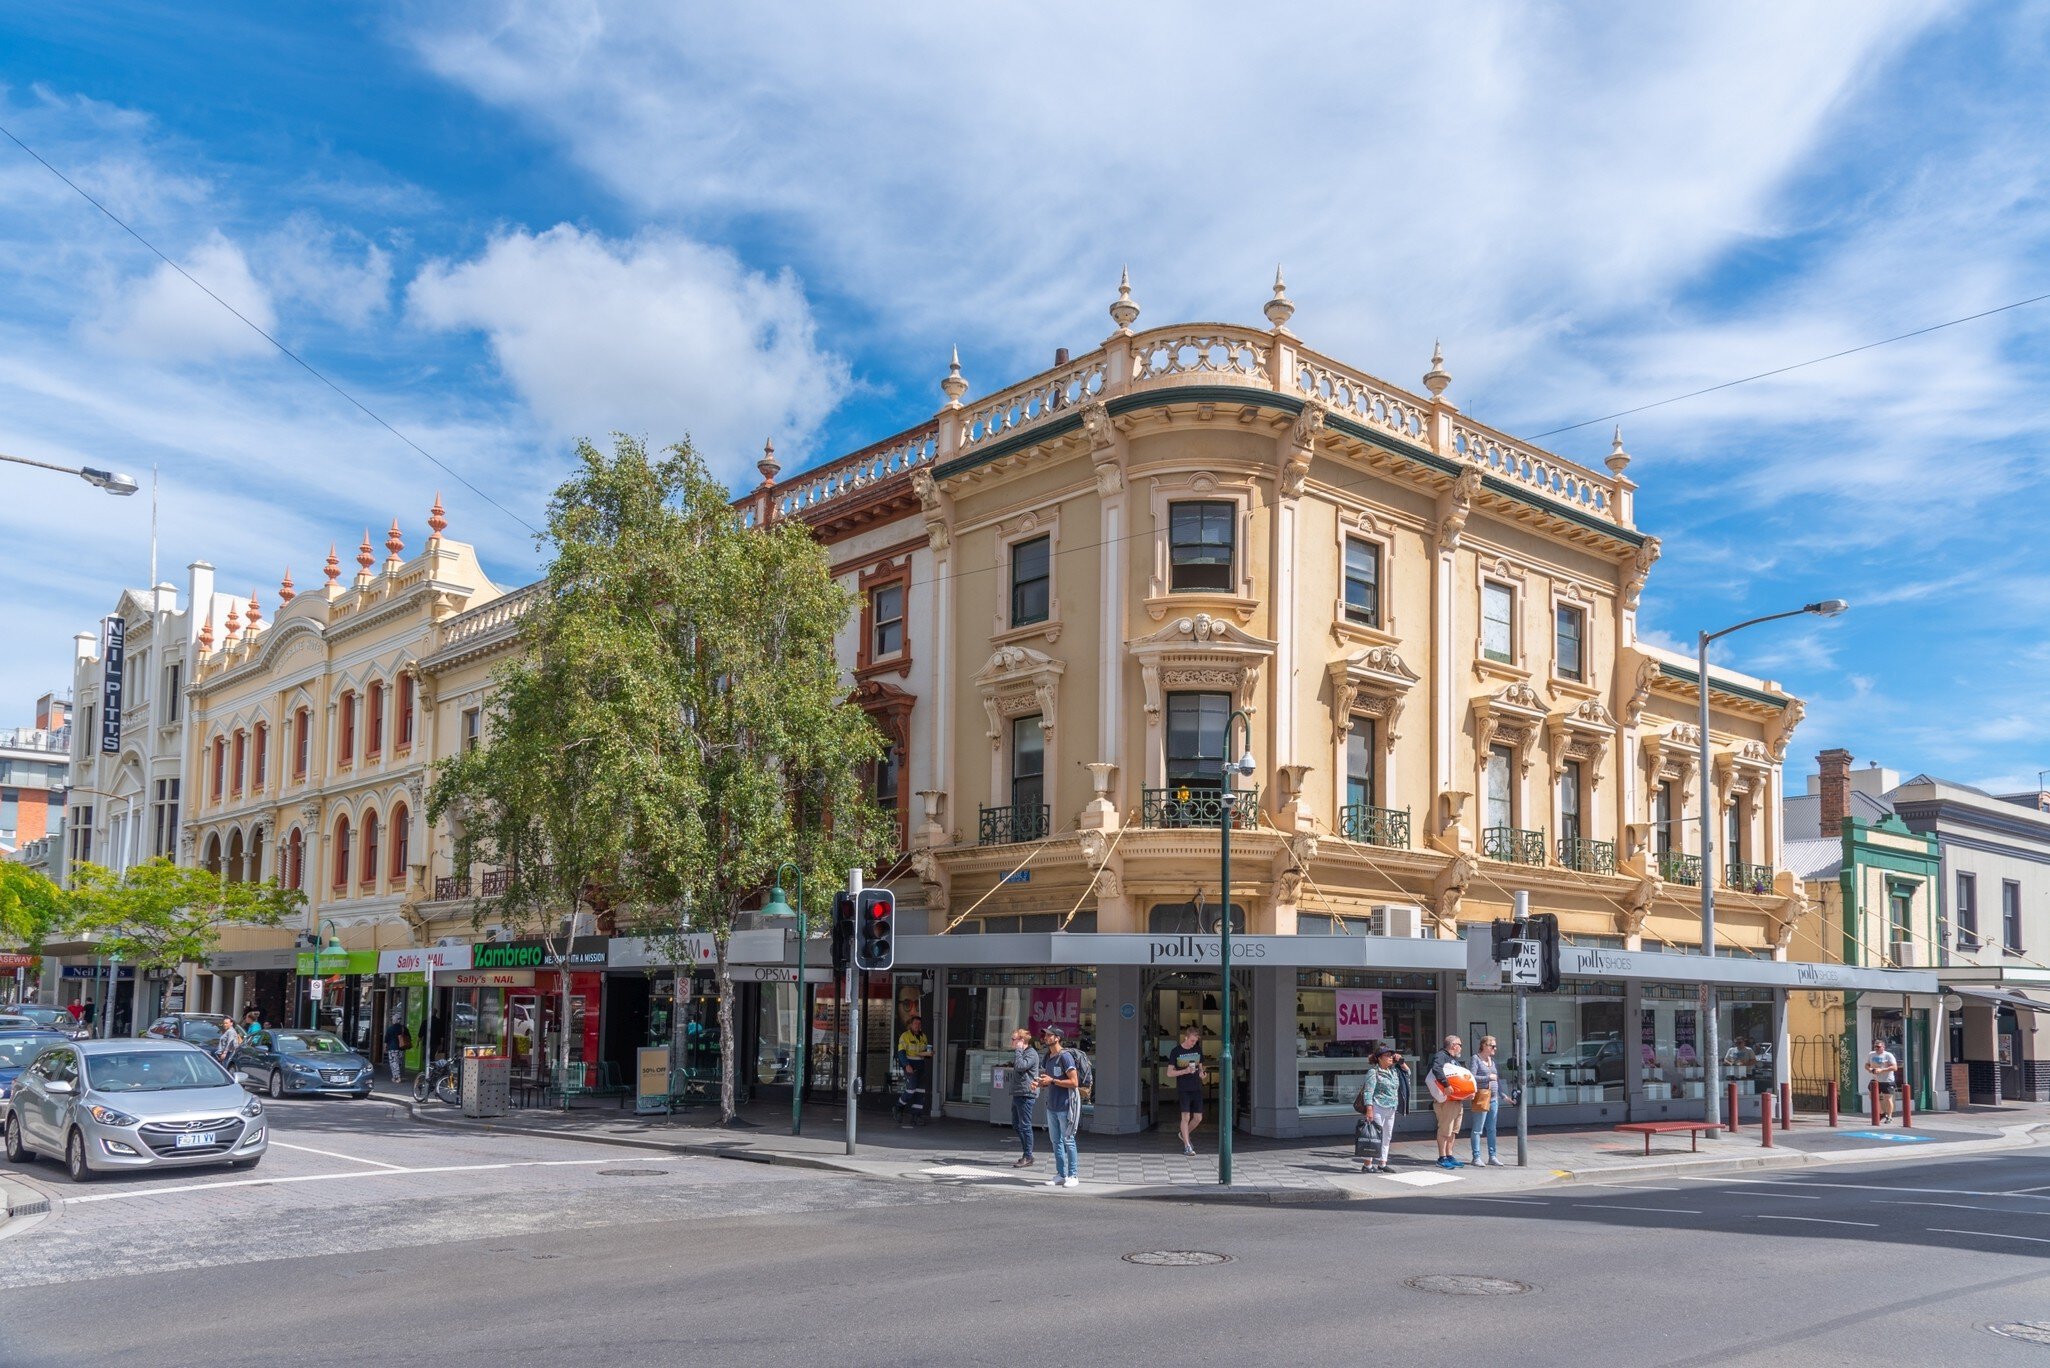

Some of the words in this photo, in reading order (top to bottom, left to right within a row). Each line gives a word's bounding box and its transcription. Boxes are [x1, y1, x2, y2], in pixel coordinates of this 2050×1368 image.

[107, 621, 123, 675] NEIL
[103, 681, 121, 750] PITT'S
[474, 943, 542, 967] Zambrero
[568, 954, 580, 963] ITH
[584, 953, 606, 963] MISSION
[1515, 944, 1537, 955] NE
[397, 955, 420, 970] Sally's
[1515, 958, 1537, 968] WAY
[73, 968, 94, 976] Neil
[100, 968, 125, 977] Pis
[456, 975, 486, 984] Sally's
[493, 975, 515, 984] NAIL
[755, 968, 790, 981] OPSM
[1033, 1001, 1078, 1023] SALE
[1339, 1003, 1379, 1026] SALE
